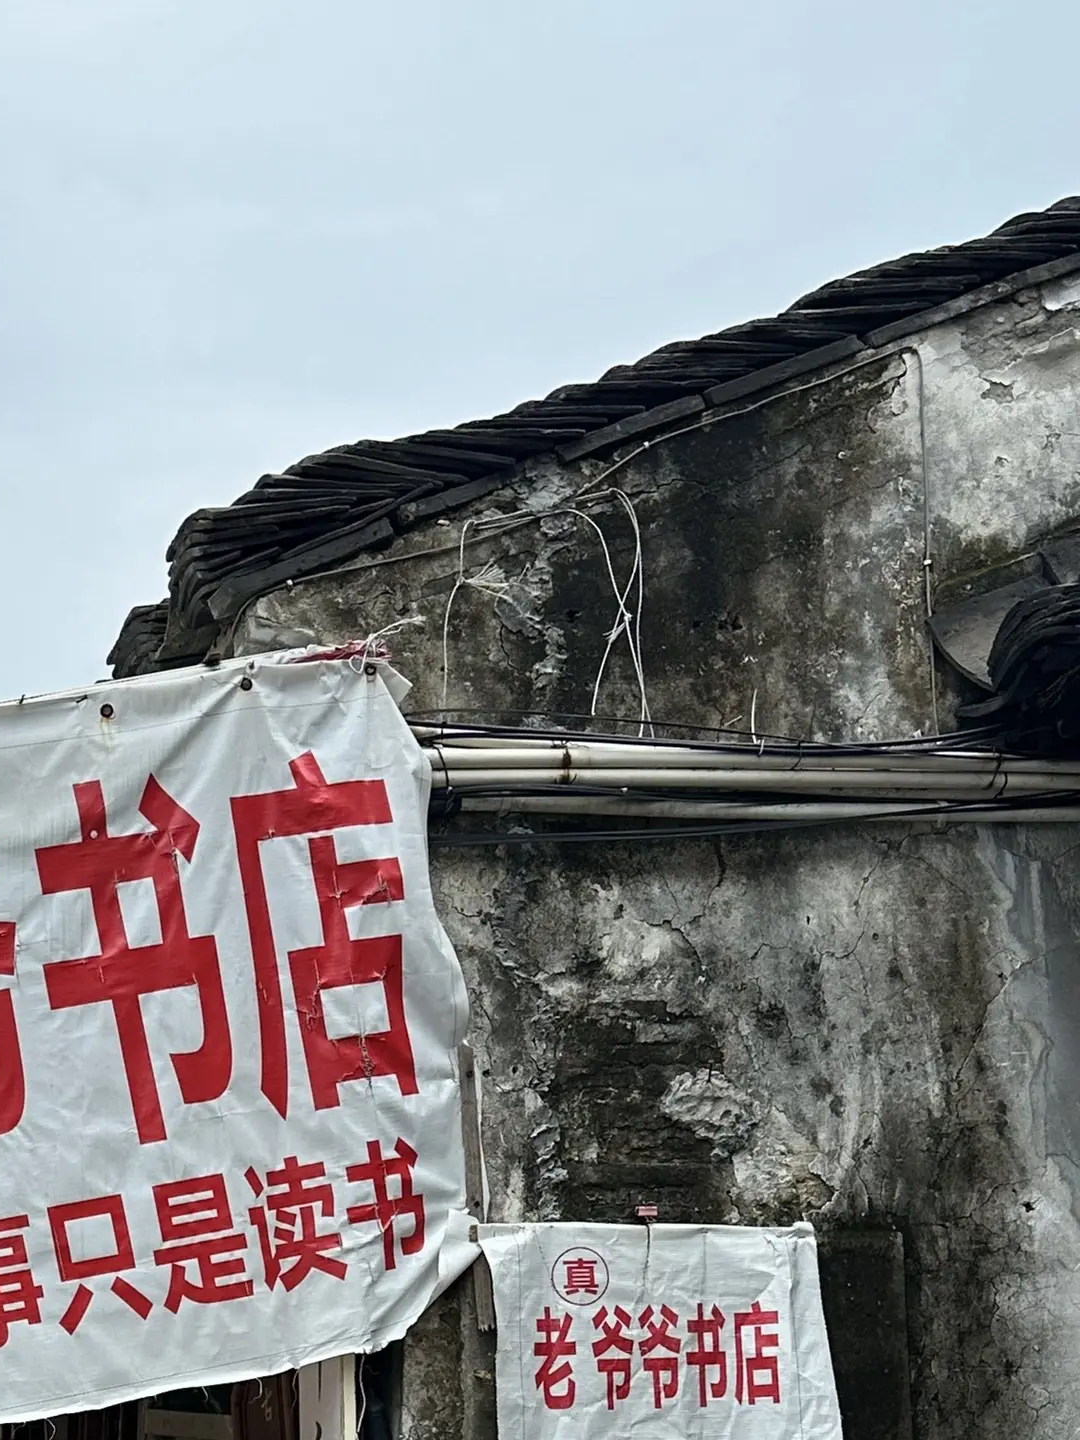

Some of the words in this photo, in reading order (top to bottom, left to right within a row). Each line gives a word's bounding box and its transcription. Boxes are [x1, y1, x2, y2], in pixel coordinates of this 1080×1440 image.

[563, 1258, 601, 1297] 真
[534, 1302, 781, 1411] 老爷爷书店
